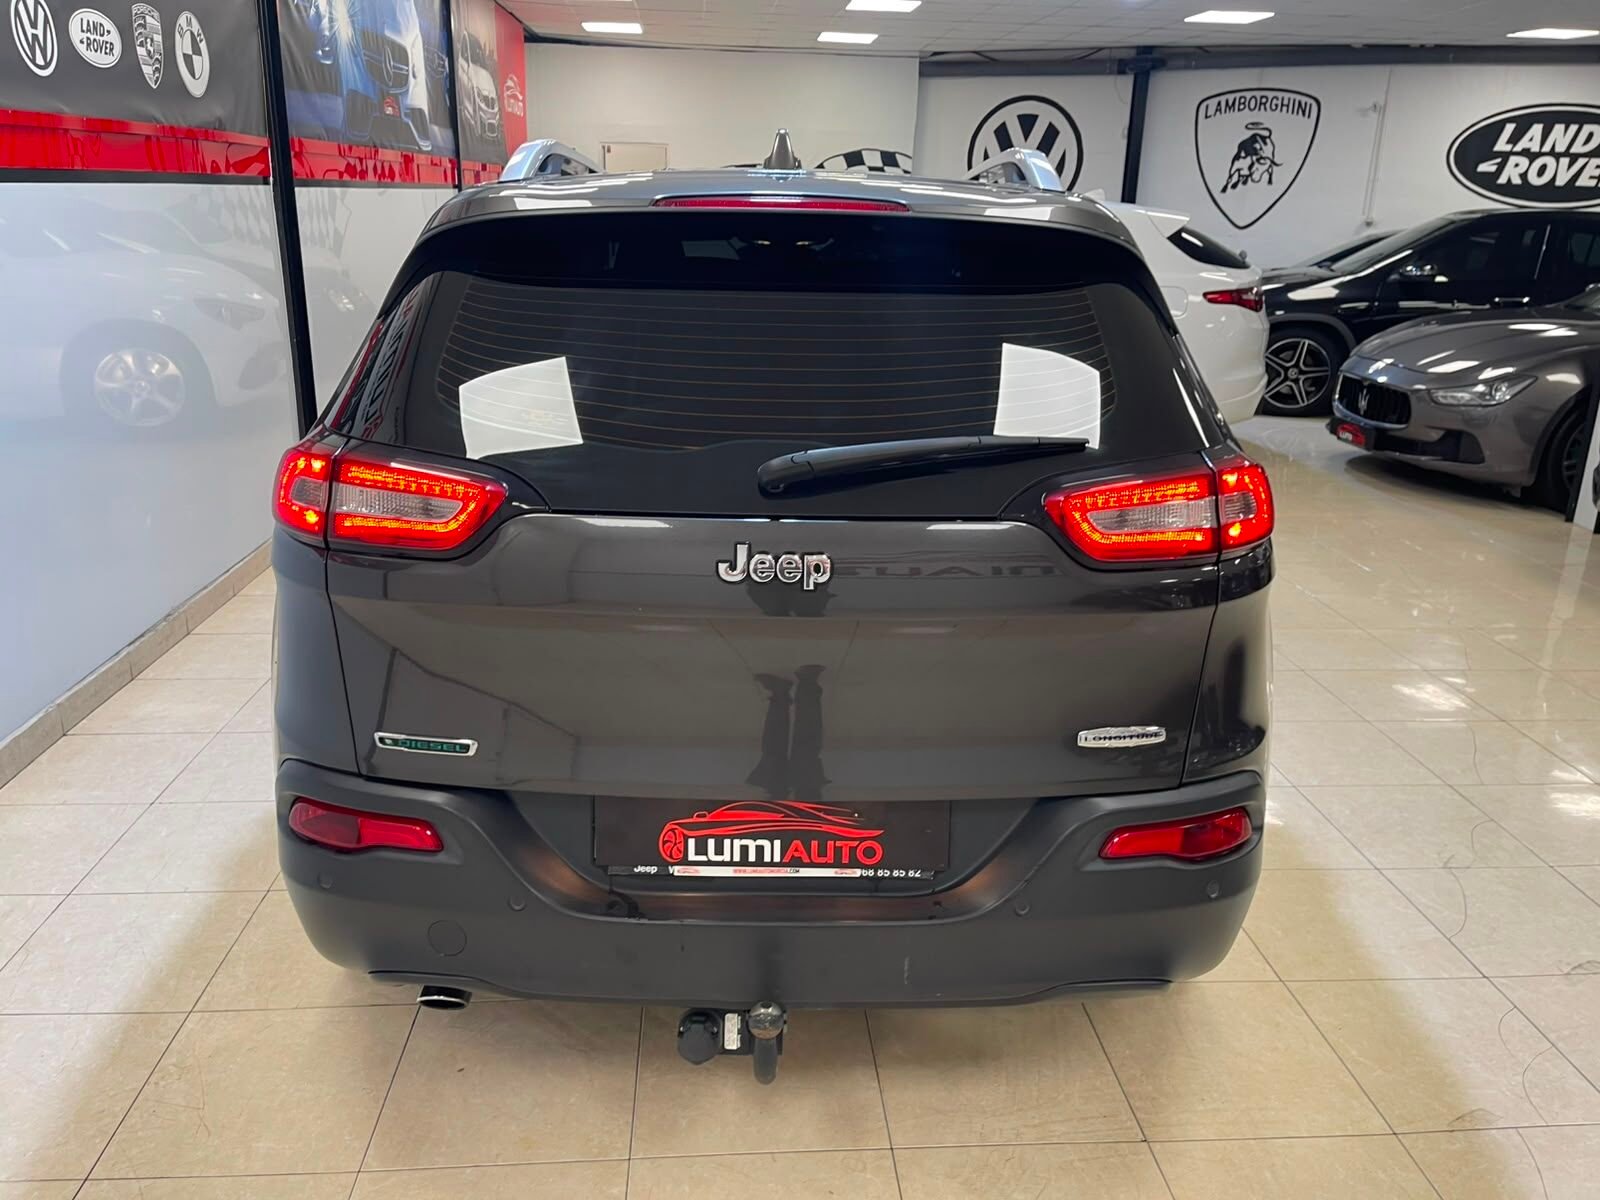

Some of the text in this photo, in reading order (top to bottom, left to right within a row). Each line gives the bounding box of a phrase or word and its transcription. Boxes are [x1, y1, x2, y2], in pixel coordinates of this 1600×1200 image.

[80, 17, 106, 37] LAND
[85, 39, 115, 57] ROVER
[1204, 95, 1313, 119] LAMBORGHINI
[1492, 122, 1600, 154] LAND
[1496, 154, 1600, 187] ROVE
[717, 541, 832, 591] Jeep
[399, 740, 465, 752] DIESEL
[633, 865, 658, 874] Jeep
